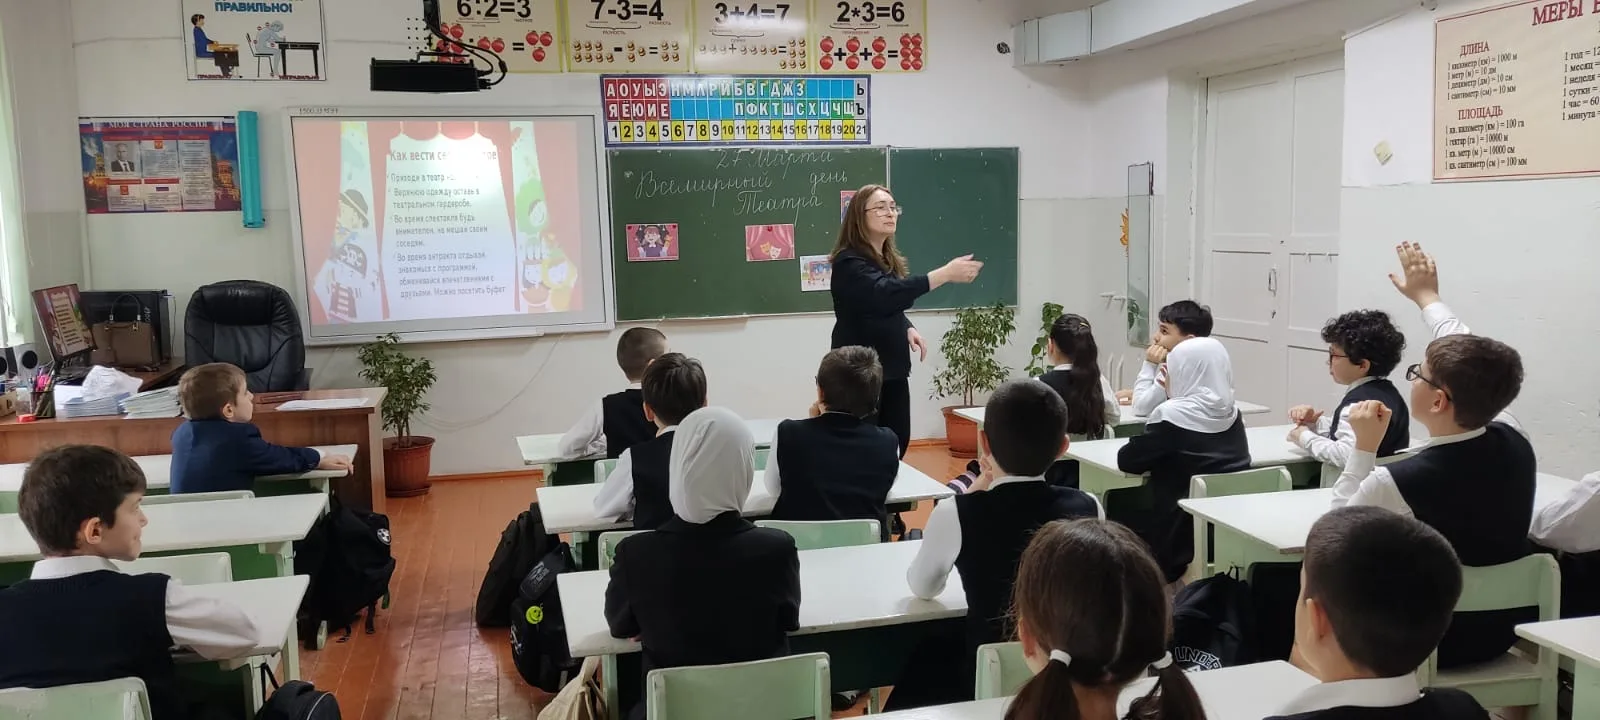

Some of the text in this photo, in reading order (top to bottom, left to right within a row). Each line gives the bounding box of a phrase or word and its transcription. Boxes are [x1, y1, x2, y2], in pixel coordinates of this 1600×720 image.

[215, 2, 292, 13] ПРАВИЛЬНО!
[1532, 0, 1583, 26] МЕРЫ
[1460, 41, 1490, 58] ДЛИНА
[1570, 62, 1593, 72] месяц
[1569, 74, 1595, 84] неделя
[607, 84, 616, 96] А
[620, 83, 628, 96] О
[630, 84, 641, 96] У
[644, 84, 656, 96] Ы
[658, 83, 667, 96] Э
[734, 82, 742, 96] Б
[746, 82, 755, 96] В
[759, 82, 766, 96] Г
[770, 82, 780, 98] Д
[782, 82, 793, 96] Ж
[796, 82, 804, 96] З
[856, 83, 864, 95] Ь
[1569, 87, 1590, 98] сутки
[1590, 96, 1600, 106] 60
[608, 101, 864, 117] Я Ё Ю И Е П Ф К Т Ш С Х Ц Ч Щ Ъ
[1458, 106, 1503, 120] ПЛОЩАДЬ
[1568, 111, 1595, 121] минута
[612, 124, 866, 138] 1 2 3 4 5 6 7 8 9 10 11 12 13 14 15 16 17 18 19 20 21
[390, 150, 434, 160] Как вести
[636, 170, 848, 208] Всемирный день
[732, 190, 824, 228] Театра
